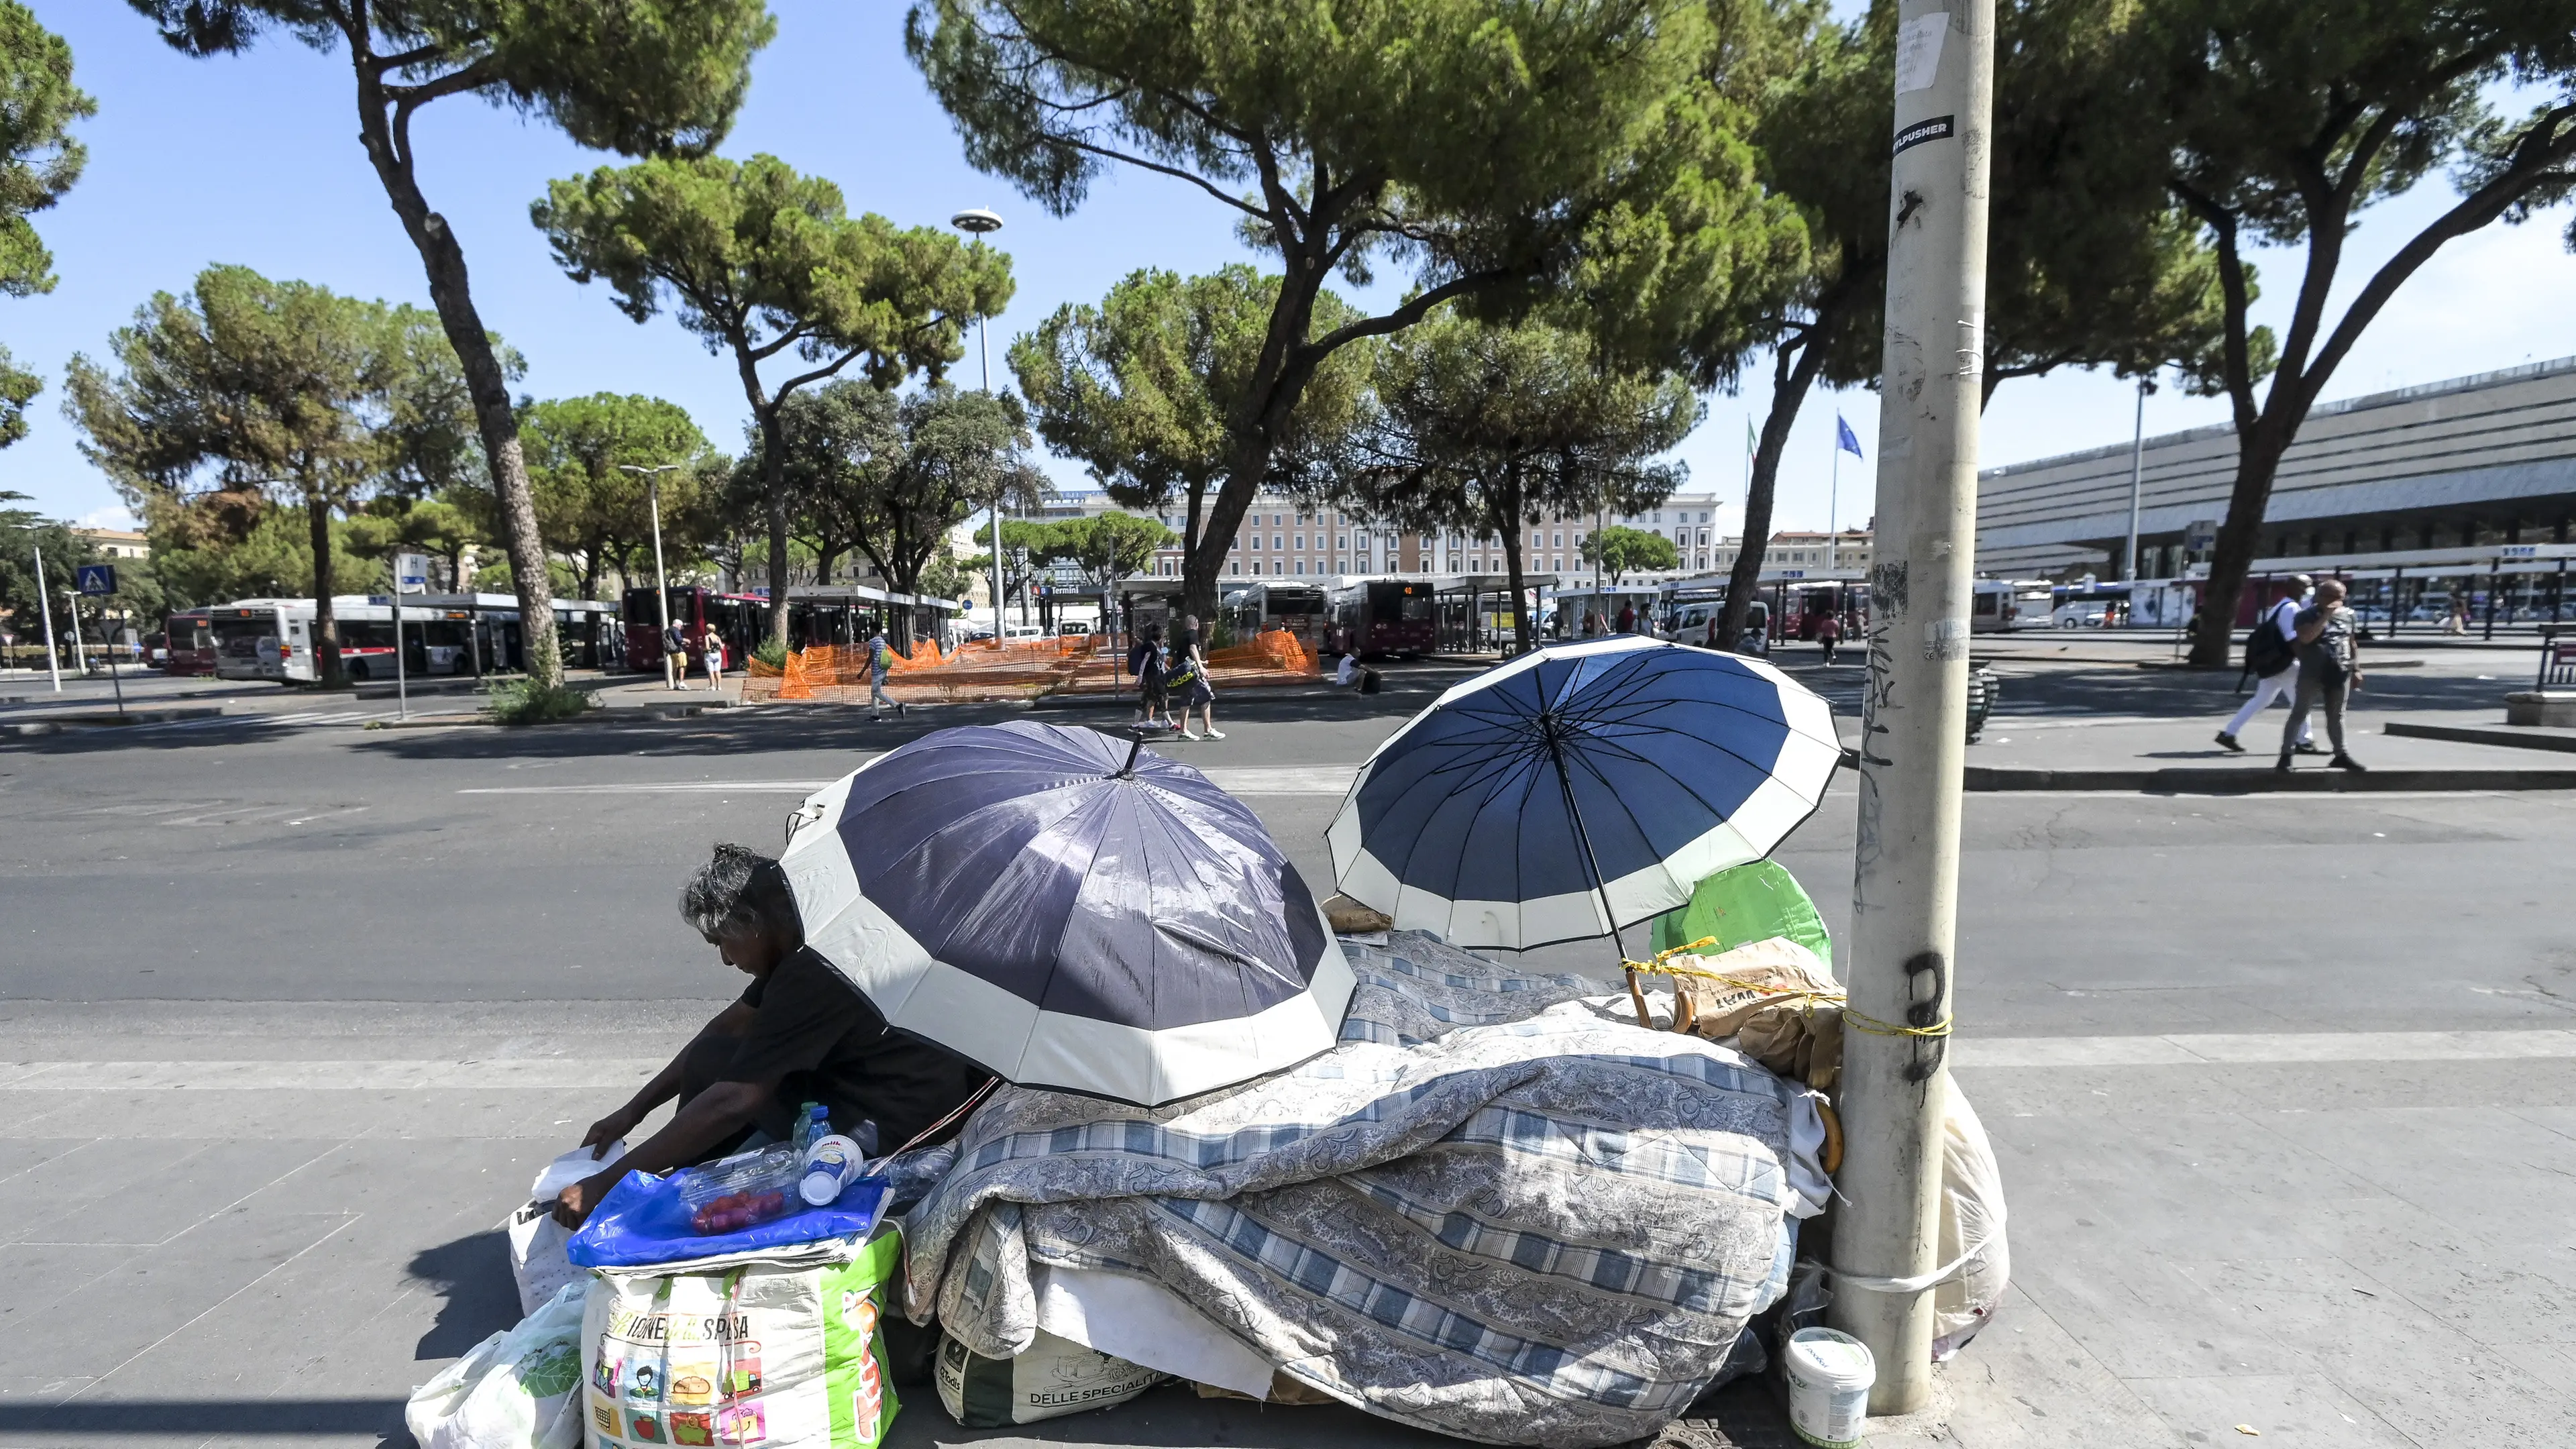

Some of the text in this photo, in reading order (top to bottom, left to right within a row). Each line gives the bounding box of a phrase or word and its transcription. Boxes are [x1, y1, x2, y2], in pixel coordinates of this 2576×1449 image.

[1051, 586, 1079, 594] Termini
[626, 1316, 667, 1340] ICONE
[1030, 1391, 1079, 1404] DELLE
